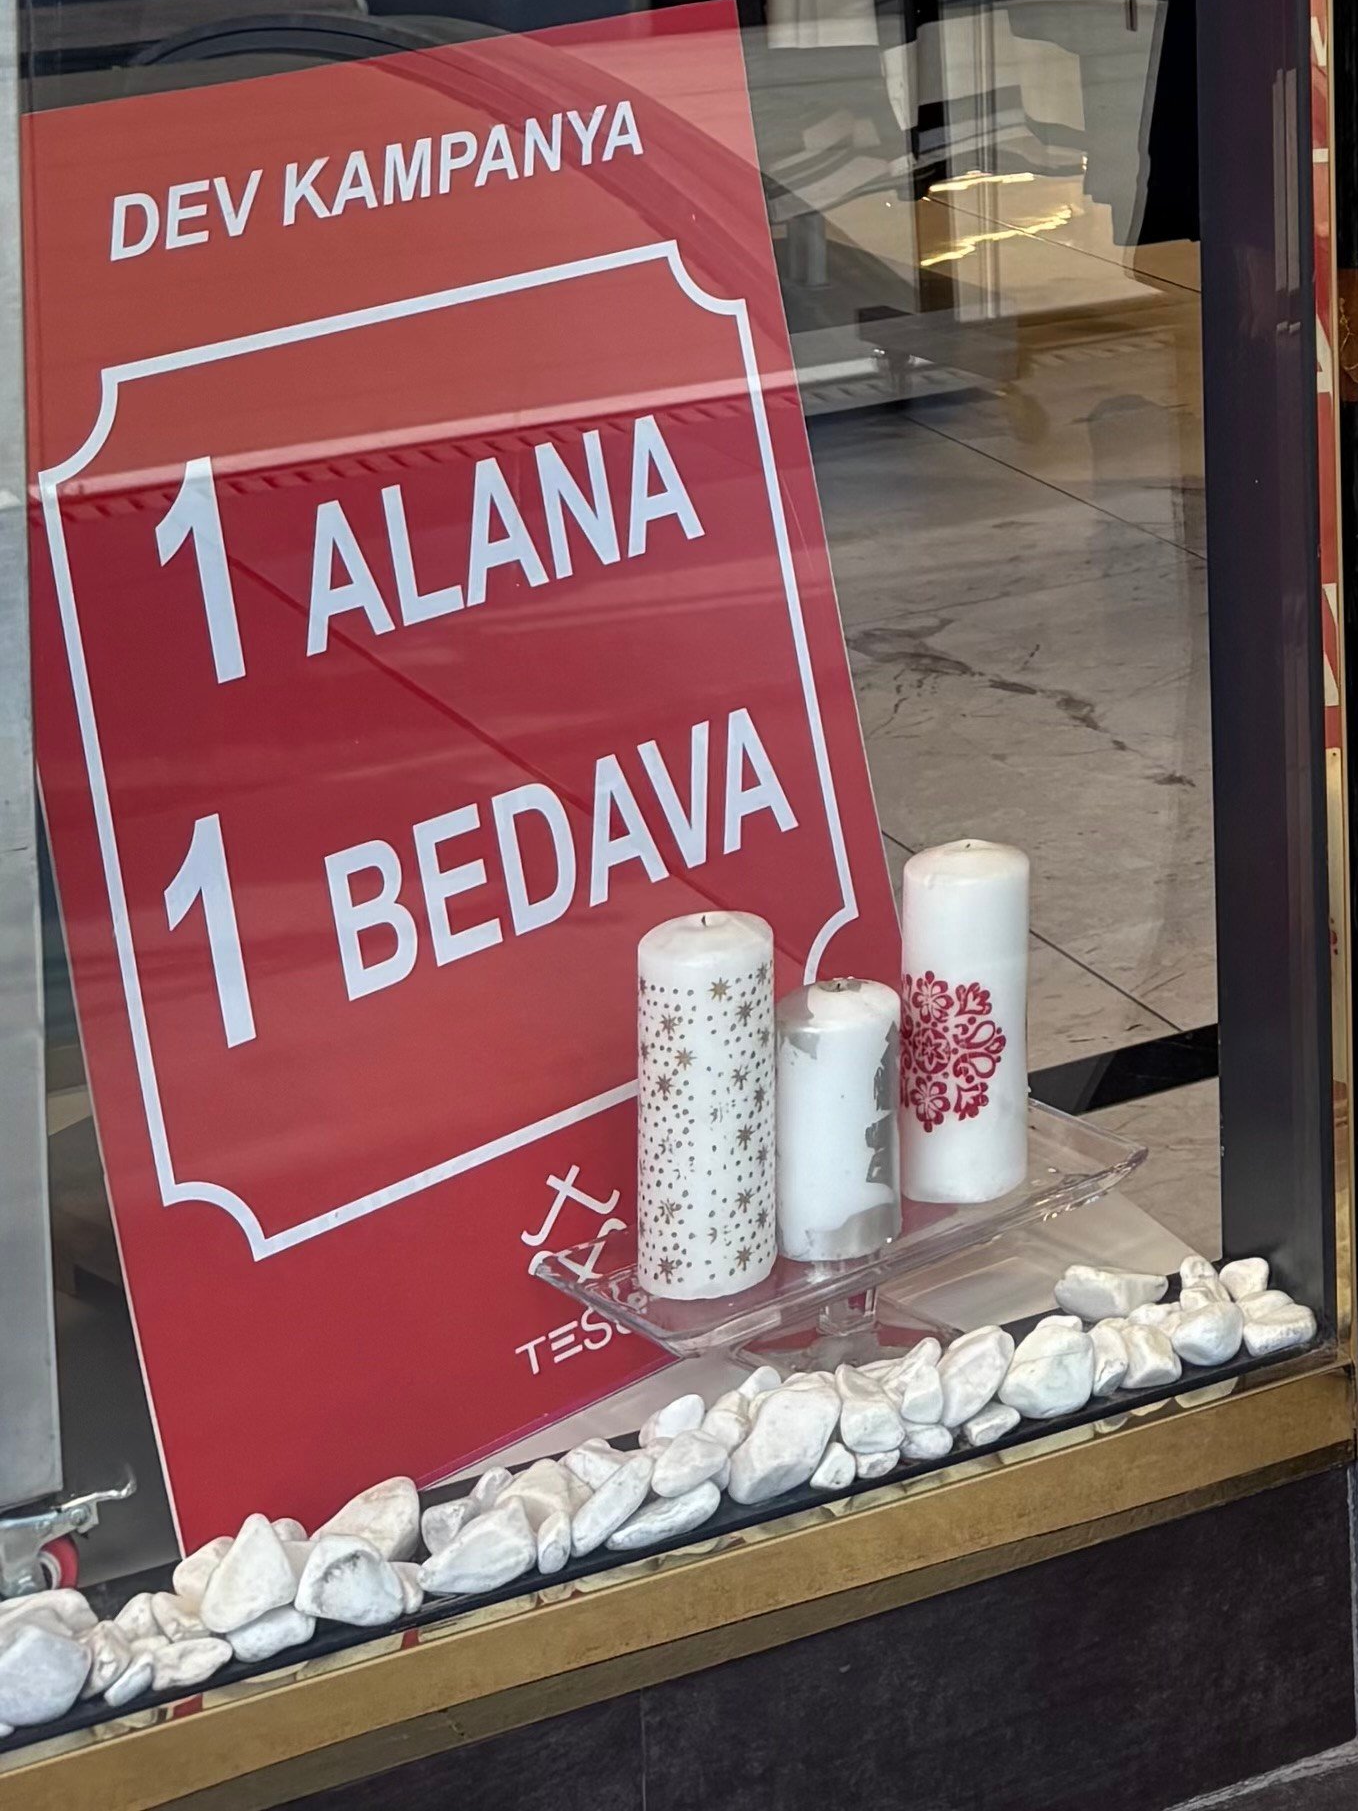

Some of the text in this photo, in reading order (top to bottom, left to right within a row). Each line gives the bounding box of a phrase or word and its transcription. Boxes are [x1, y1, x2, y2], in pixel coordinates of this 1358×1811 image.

[109, 98, 646, 264] DEV KAMPANYA
[154, 414, 706, 684] 1 ALANA
[163, 706, 798, 1051] 1 BEDAVA
